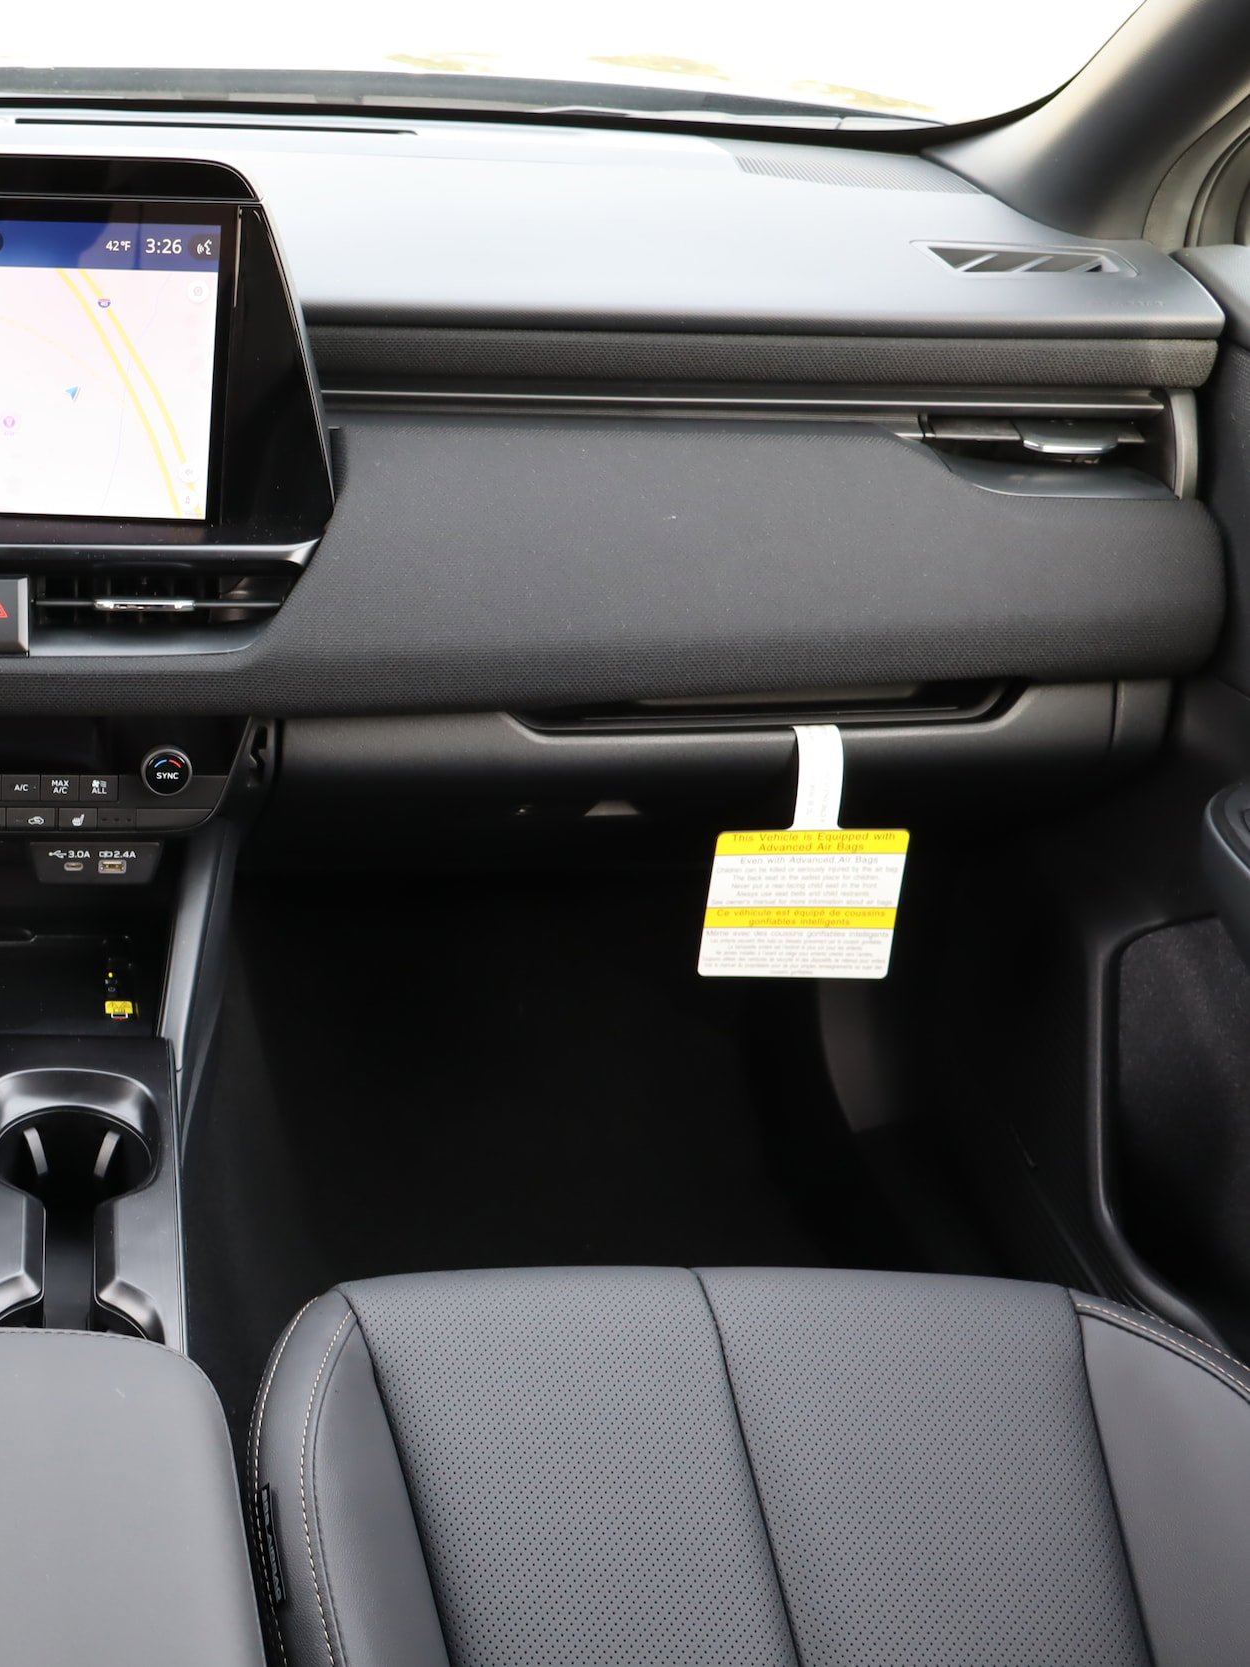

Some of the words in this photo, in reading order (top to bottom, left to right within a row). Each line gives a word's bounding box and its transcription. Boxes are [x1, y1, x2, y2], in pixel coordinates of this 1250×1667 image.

[145, 238, 182, 254] 3:26
[156, 772, 179, 780] SYNC
[14, 784, 29, 792] A/C
[91, 787, 107, 795] ALL
[733, 833, 754, 842] This
[759, 832, 798, 841] Vehicle
[803, 832, 812, 841] is
[817, 831, 869, 842] Equipped
[874, 831, 896, 840] with
[758, 843, 812, 852] Advanced
[817, 843, 831, 851] Air
[837, 842, 864, 852] Bags
[68, 850, 91, 858] 3.0A
[113, 850, 136, 858] 2.4A
[740, 856, 763, 864] Even
[766, 856, 785, 864] with
[838, 855, 851, 863] Air
[855, 855, 878, 864] Bags
[716, 909, 730, 917] Ce
[776, 909, 790, 917] est
[829, 909, 841, 917] de
[844, 910, 886, 918] coussins
[749, 918, 796, 927] gonflables
[800, 918, 850, 927] intelligents
